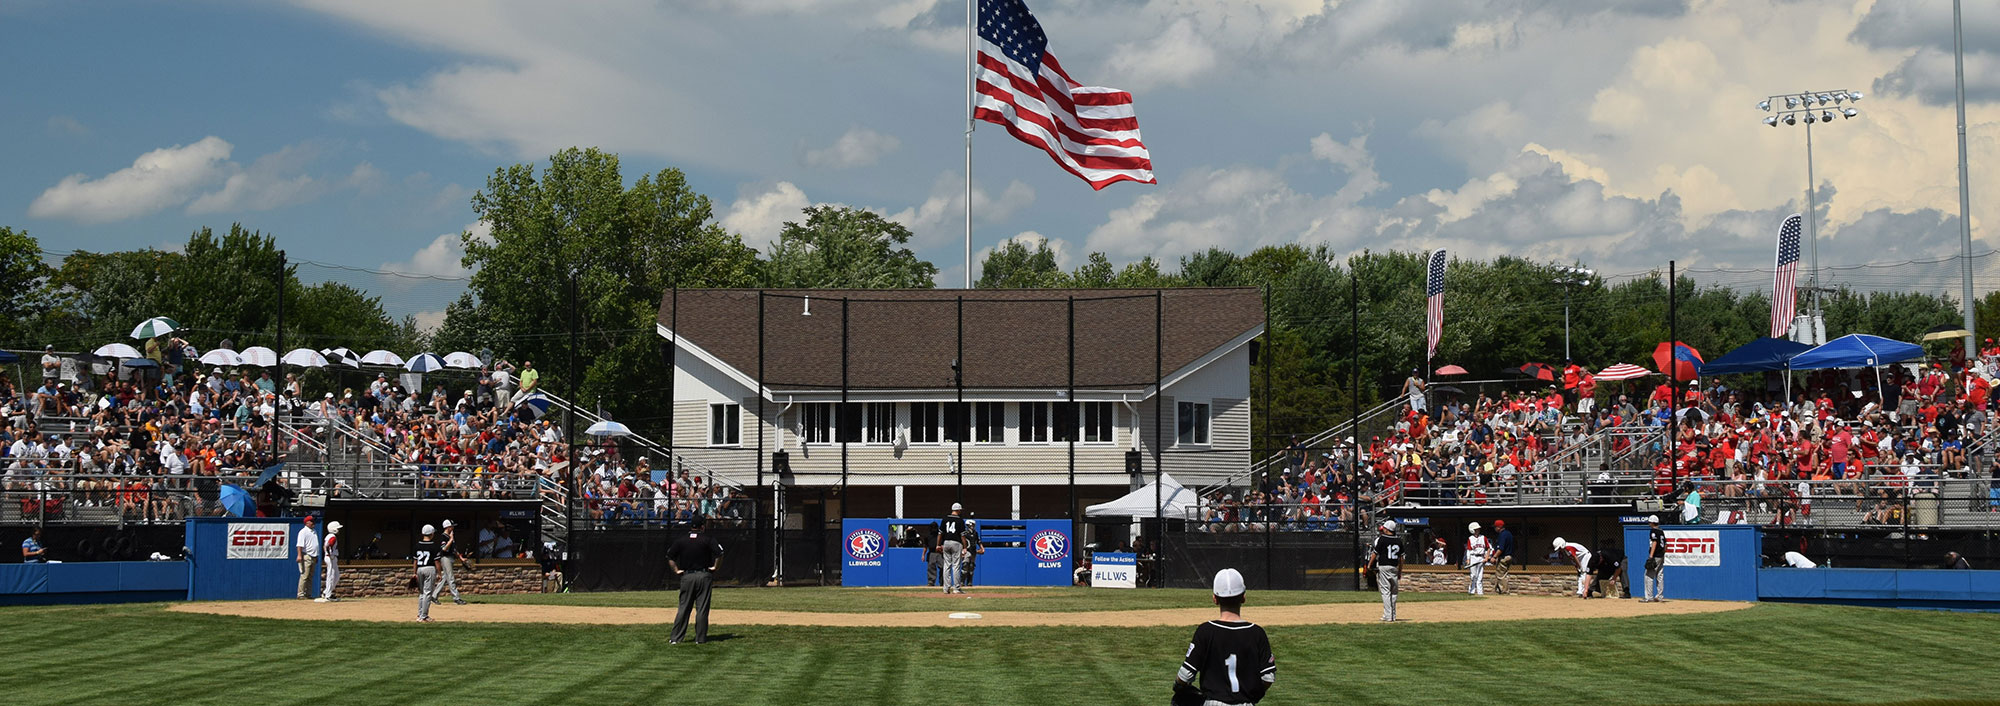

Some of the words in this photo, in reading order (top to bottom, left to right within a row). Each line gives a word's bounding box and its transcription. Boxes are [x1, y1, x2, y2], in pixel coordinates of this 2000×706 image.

[946, 521, 956, 533] 14
[231, 530, 285, 546] ESPN
[1665, 538, 1715, 553] ESPN
[416, 550, 430, 565] 27
[852, 551, 880, 559] BASEBALL
[1036, 552, 1064, 560] BASEBALL
[1387, 544, 1400, 559] 12
[1095, 571, 1127, 580] #LLWS
[1224, 653, 1240, 693] 1
